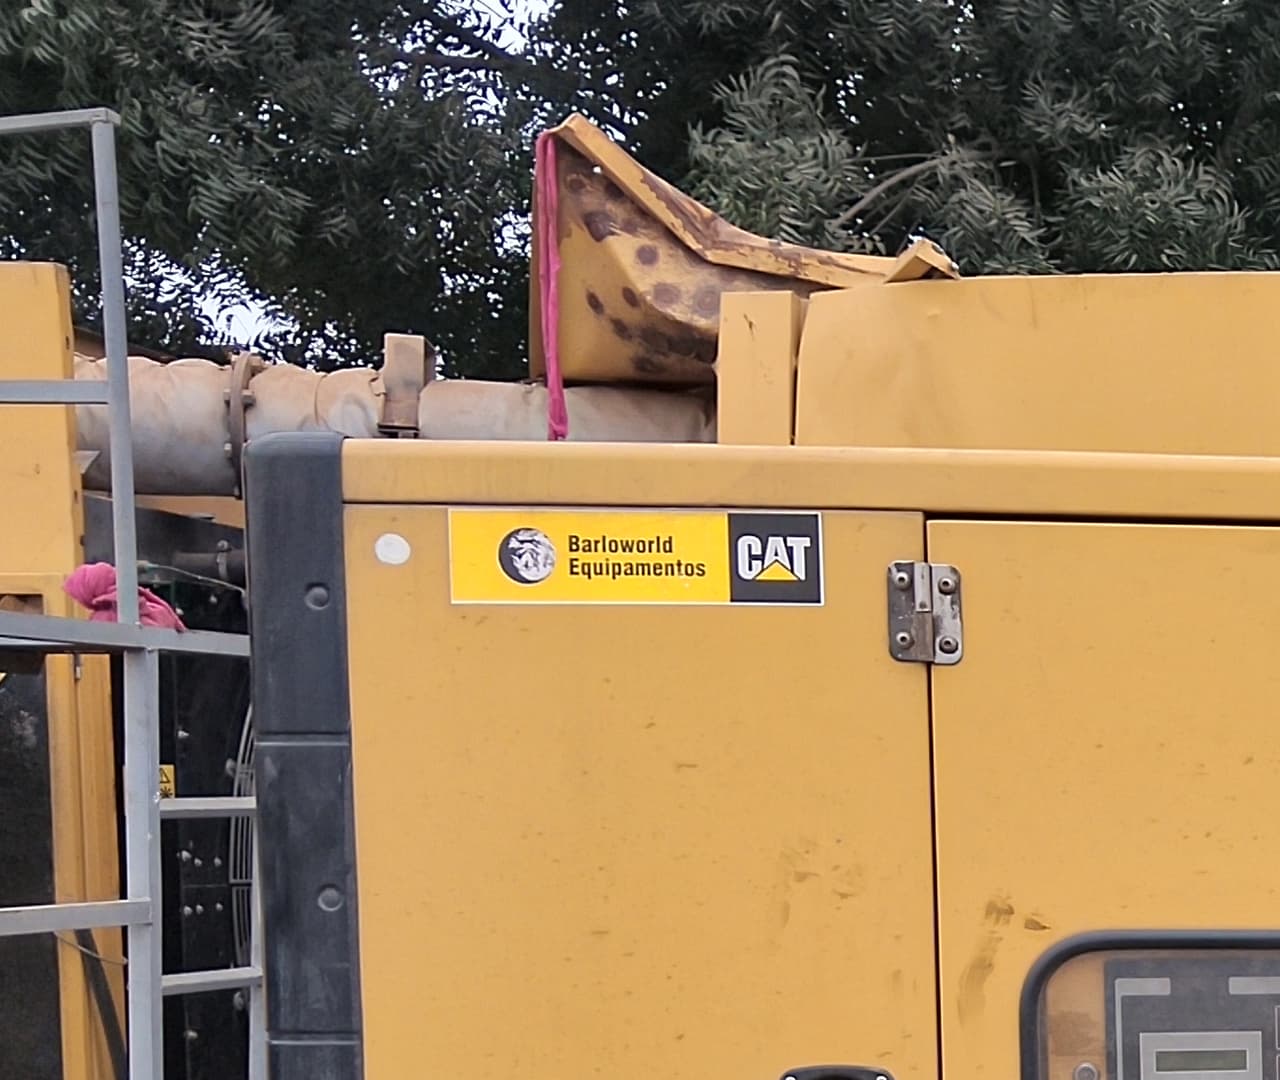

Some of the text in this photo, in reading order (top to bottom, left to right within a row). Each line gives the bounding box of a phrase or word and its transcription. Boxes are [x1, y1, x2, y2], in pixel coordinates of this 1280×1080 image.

[568, 535, 674, 554] Barloworld
[568, 557, 706, 581] Equipamentos
[736, 534, 811, 581] CAT
